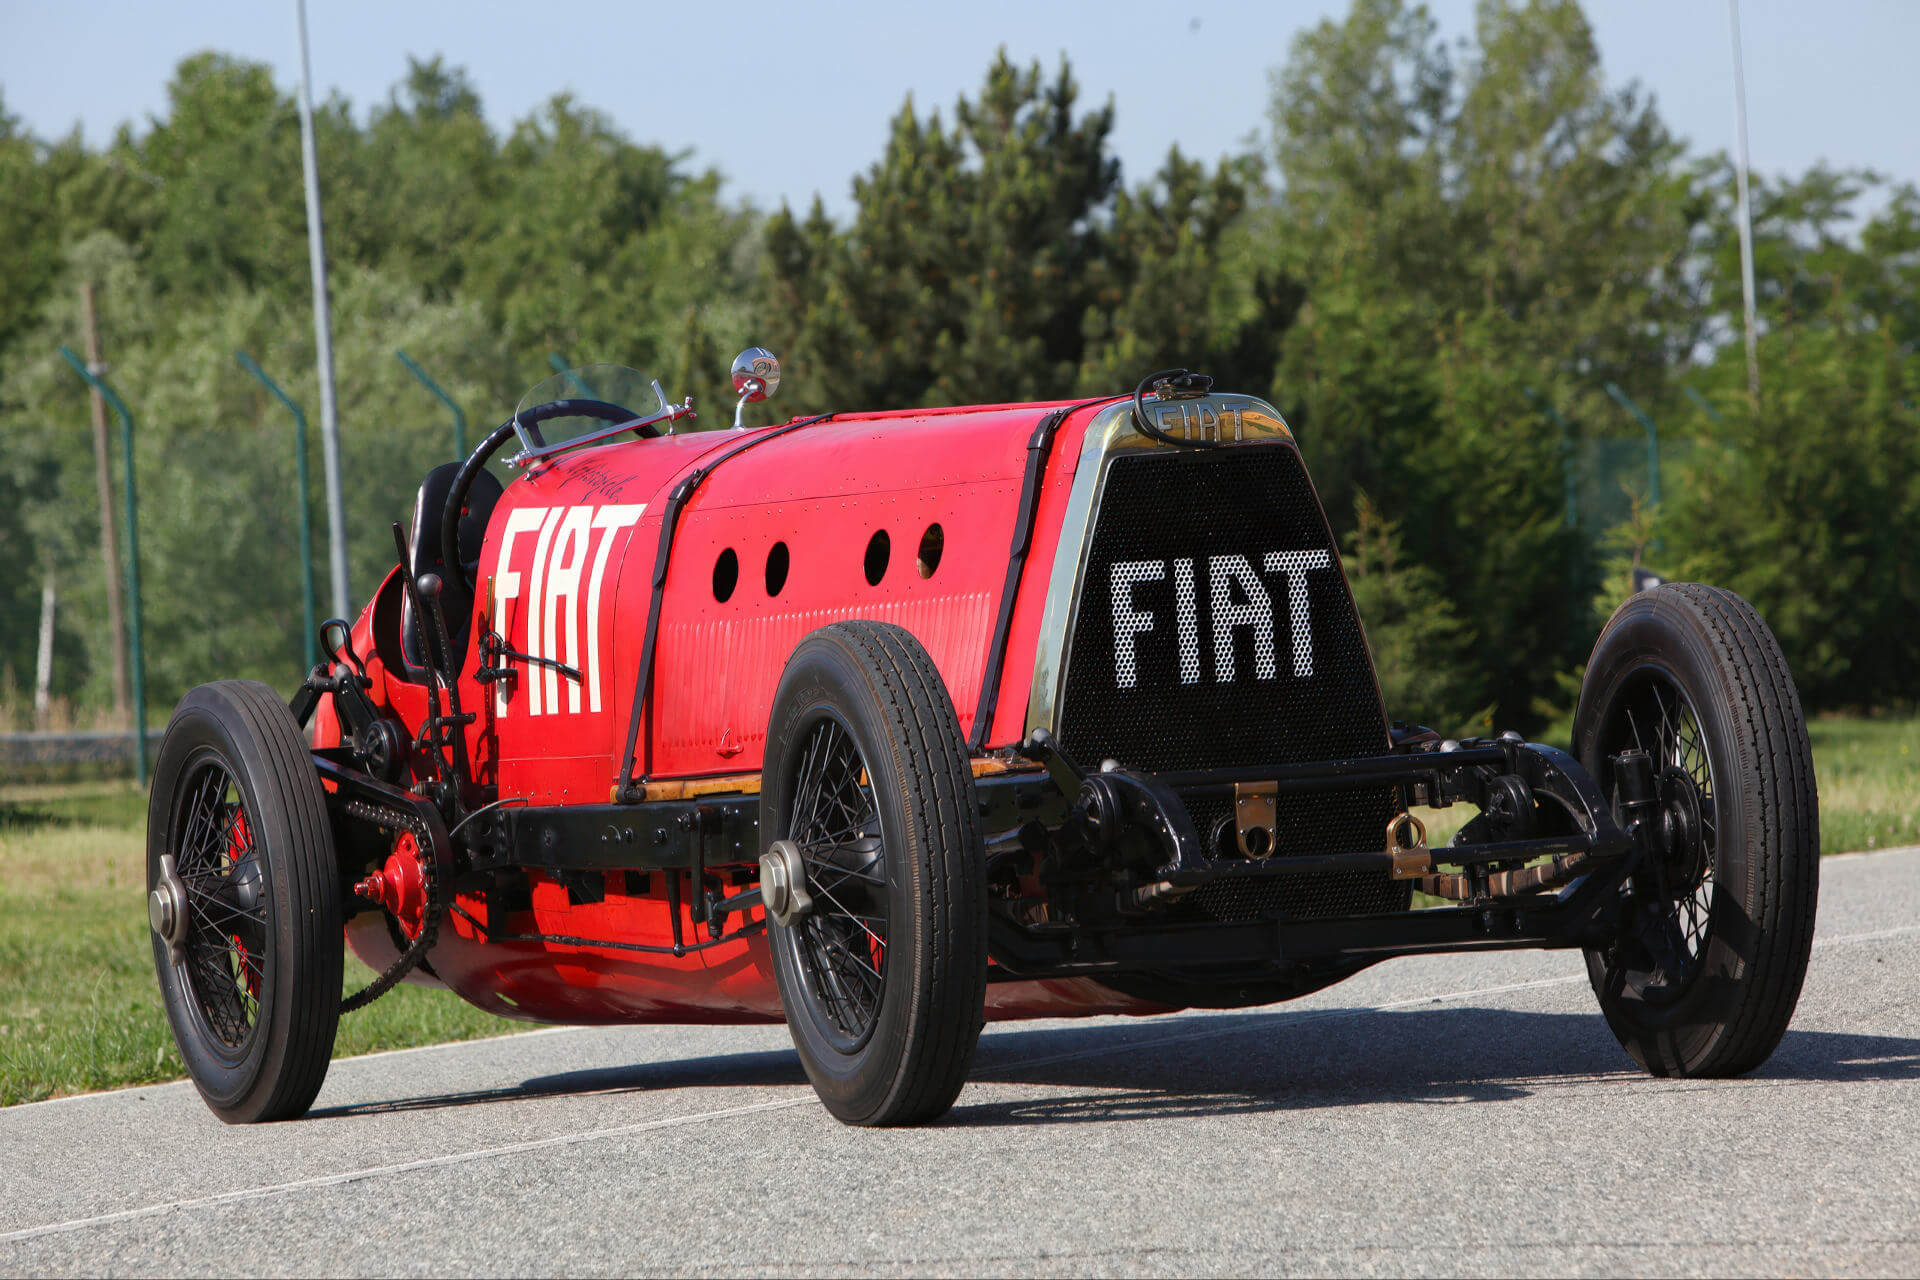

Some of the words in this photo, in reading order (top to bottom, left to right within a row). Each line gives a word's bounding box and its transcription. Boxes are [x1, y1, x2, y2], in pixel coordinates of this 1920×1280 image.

[1154, 402, 1250, 447] FIAT
[495, 504, 648, 717] FIAT
[1111, 550, 1330, 688] FIAT
